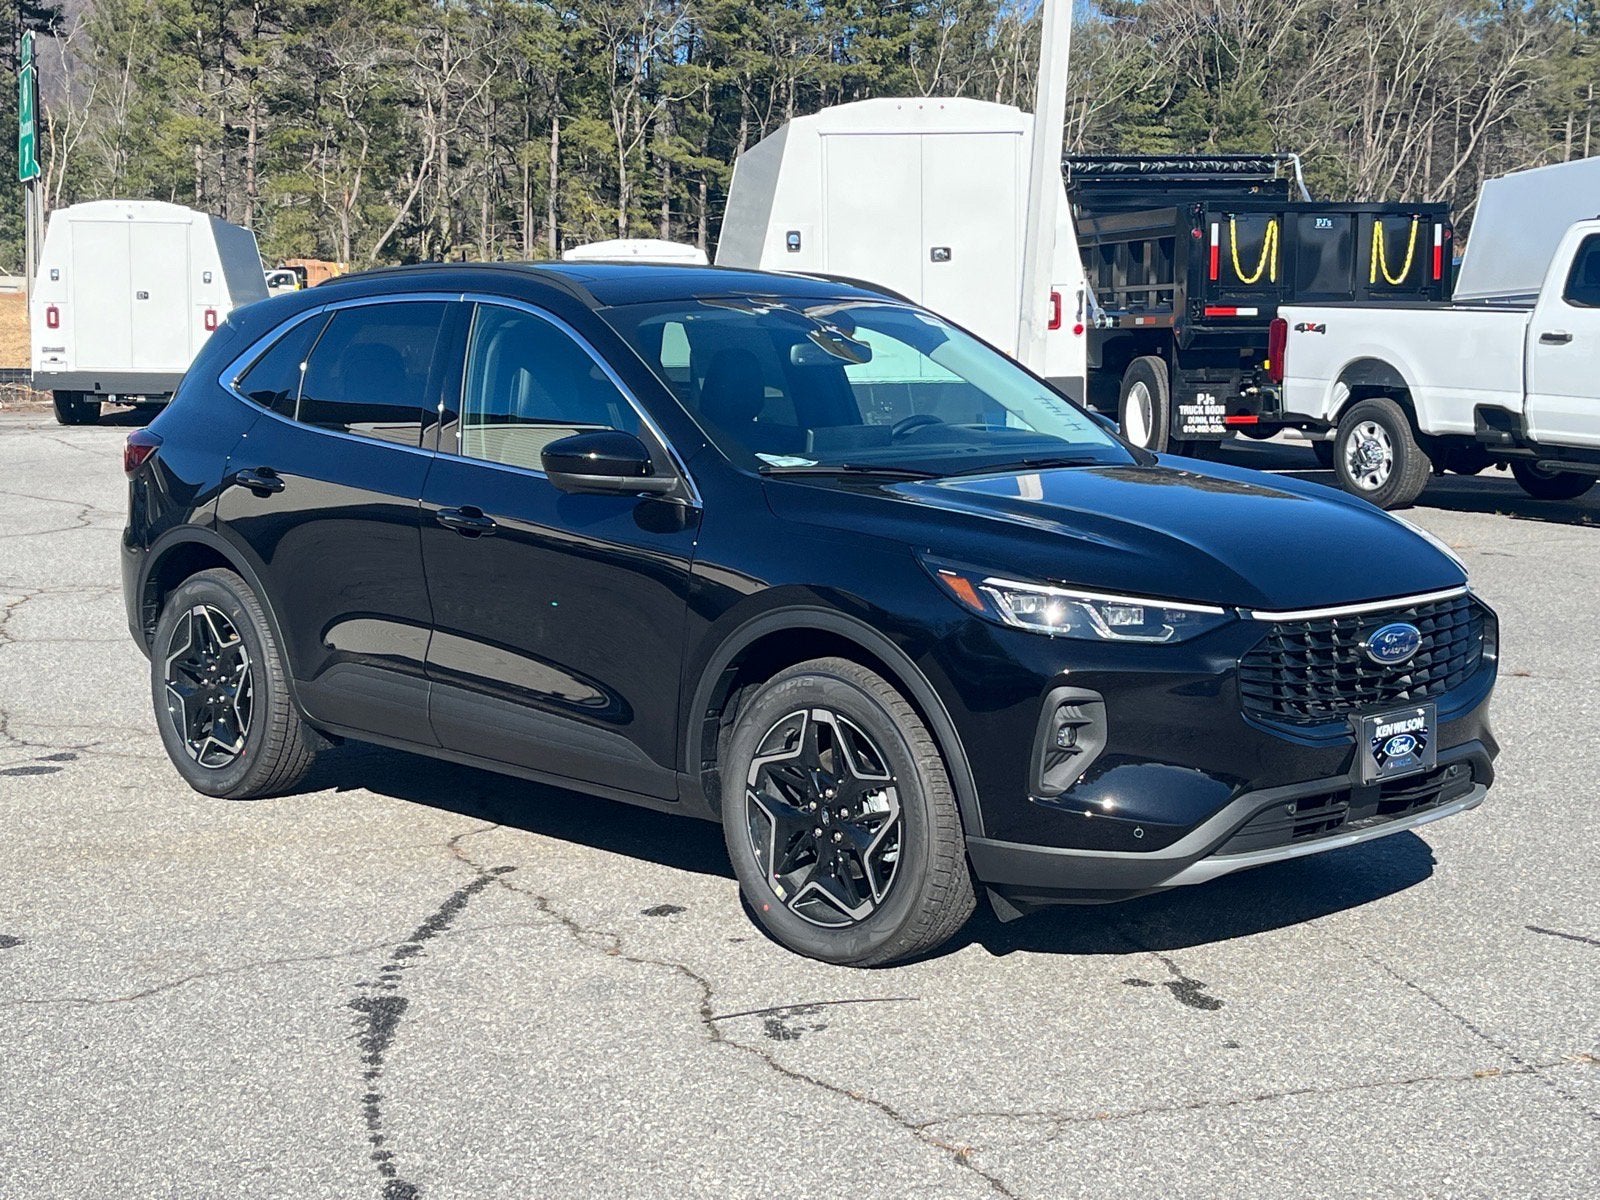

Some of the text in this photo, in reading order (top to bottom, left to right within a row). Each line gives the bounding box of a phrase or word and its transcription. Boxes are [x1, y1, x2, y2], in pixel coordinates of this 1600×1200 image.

[1179, 405, 1204, 415] TRUCK
[1375, 716, 1424, 738] KEN WILSON
